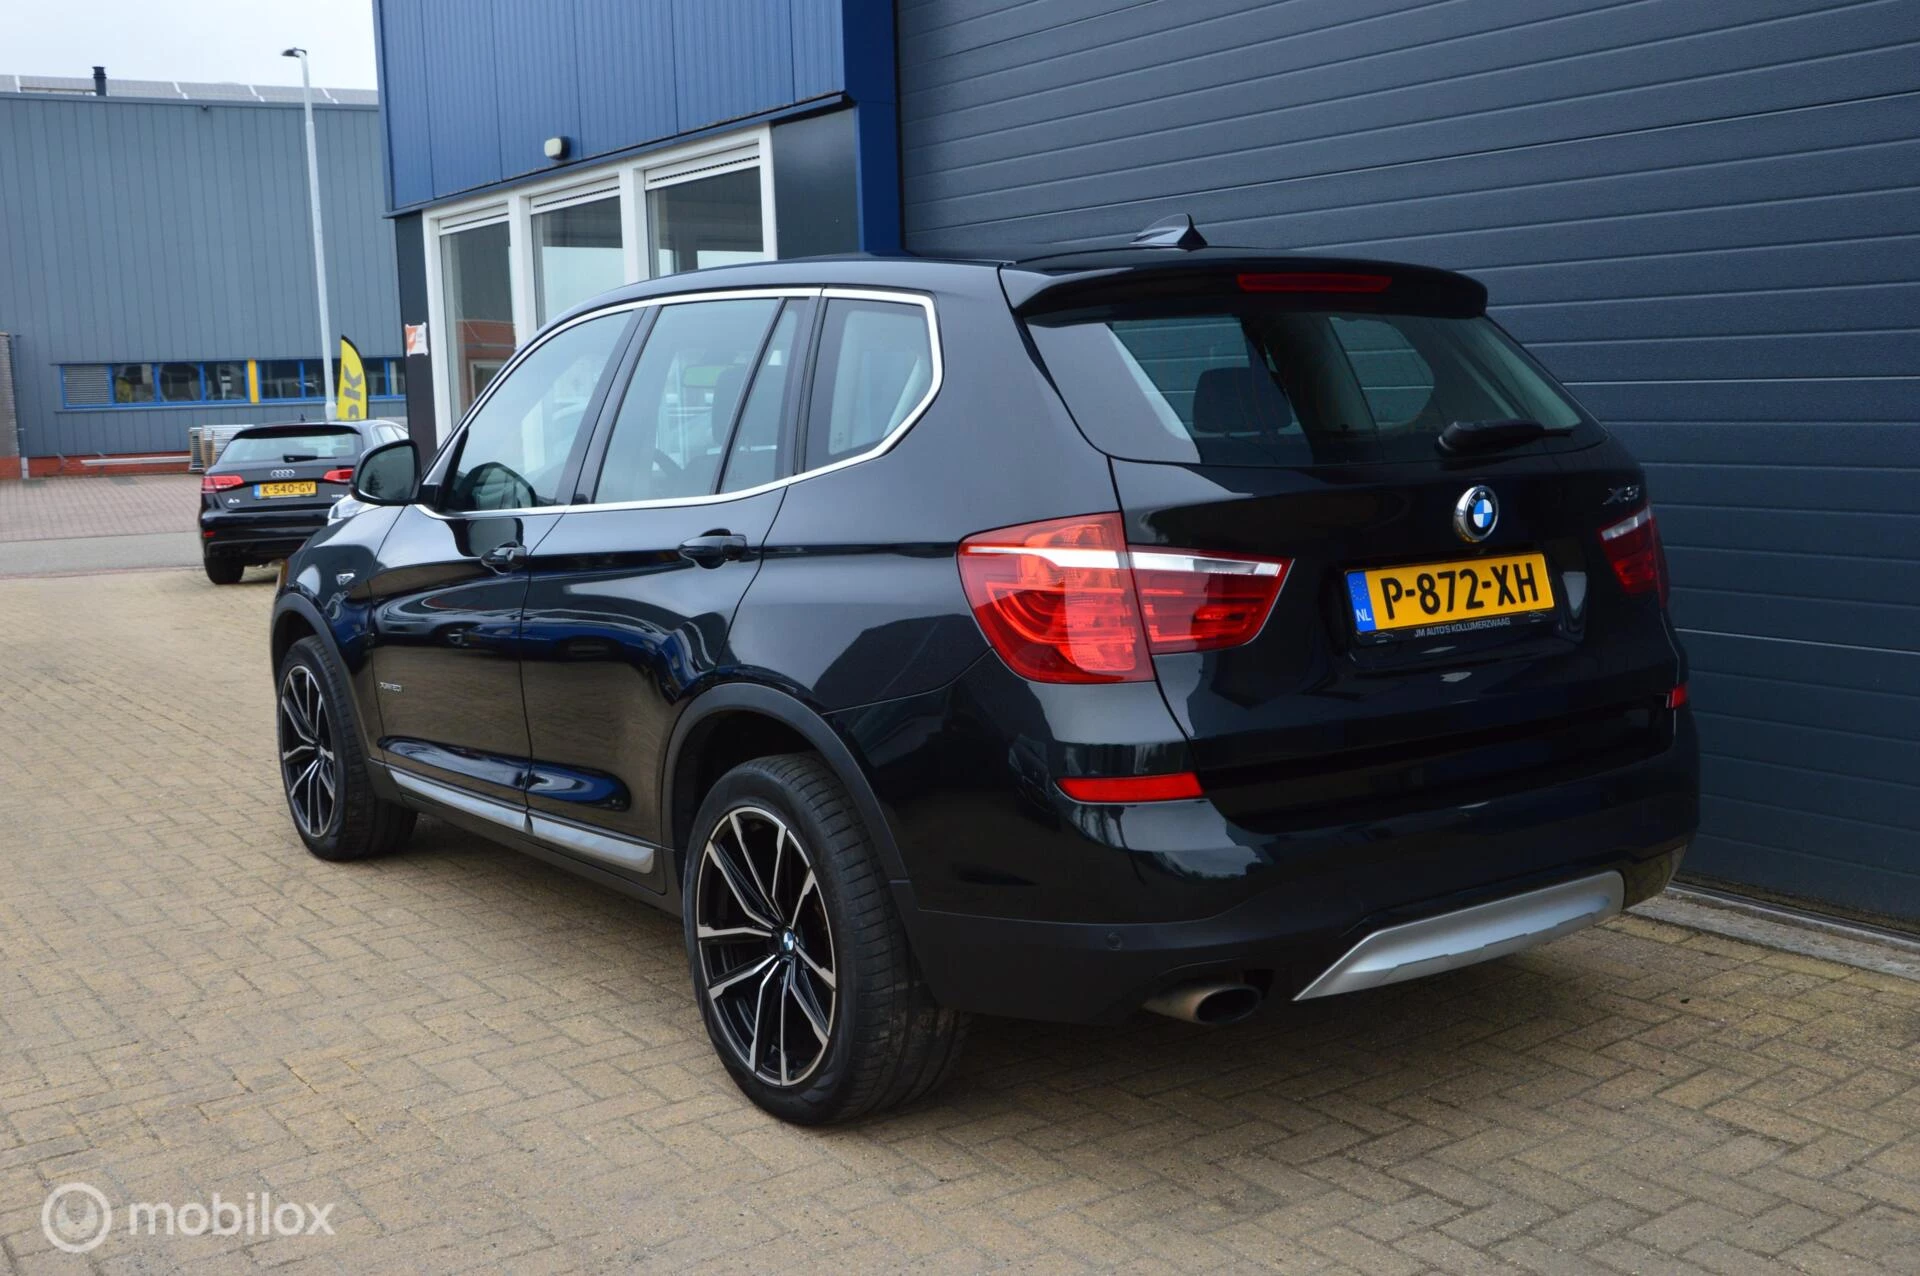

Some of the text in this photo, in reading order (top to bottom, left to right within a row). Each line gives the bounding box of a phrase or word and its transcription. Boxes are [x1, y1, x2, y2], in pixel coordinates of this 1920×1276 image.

[262, 483, 313, 495] K-540-GV
[1380, 562, 1539, 620] P-872-XH
[1356, 608, 1372, 622] NL
[1415, 629, 1425, 637] JM
[1452, 618, 1510, 632] KOLLUMERZWAAG
